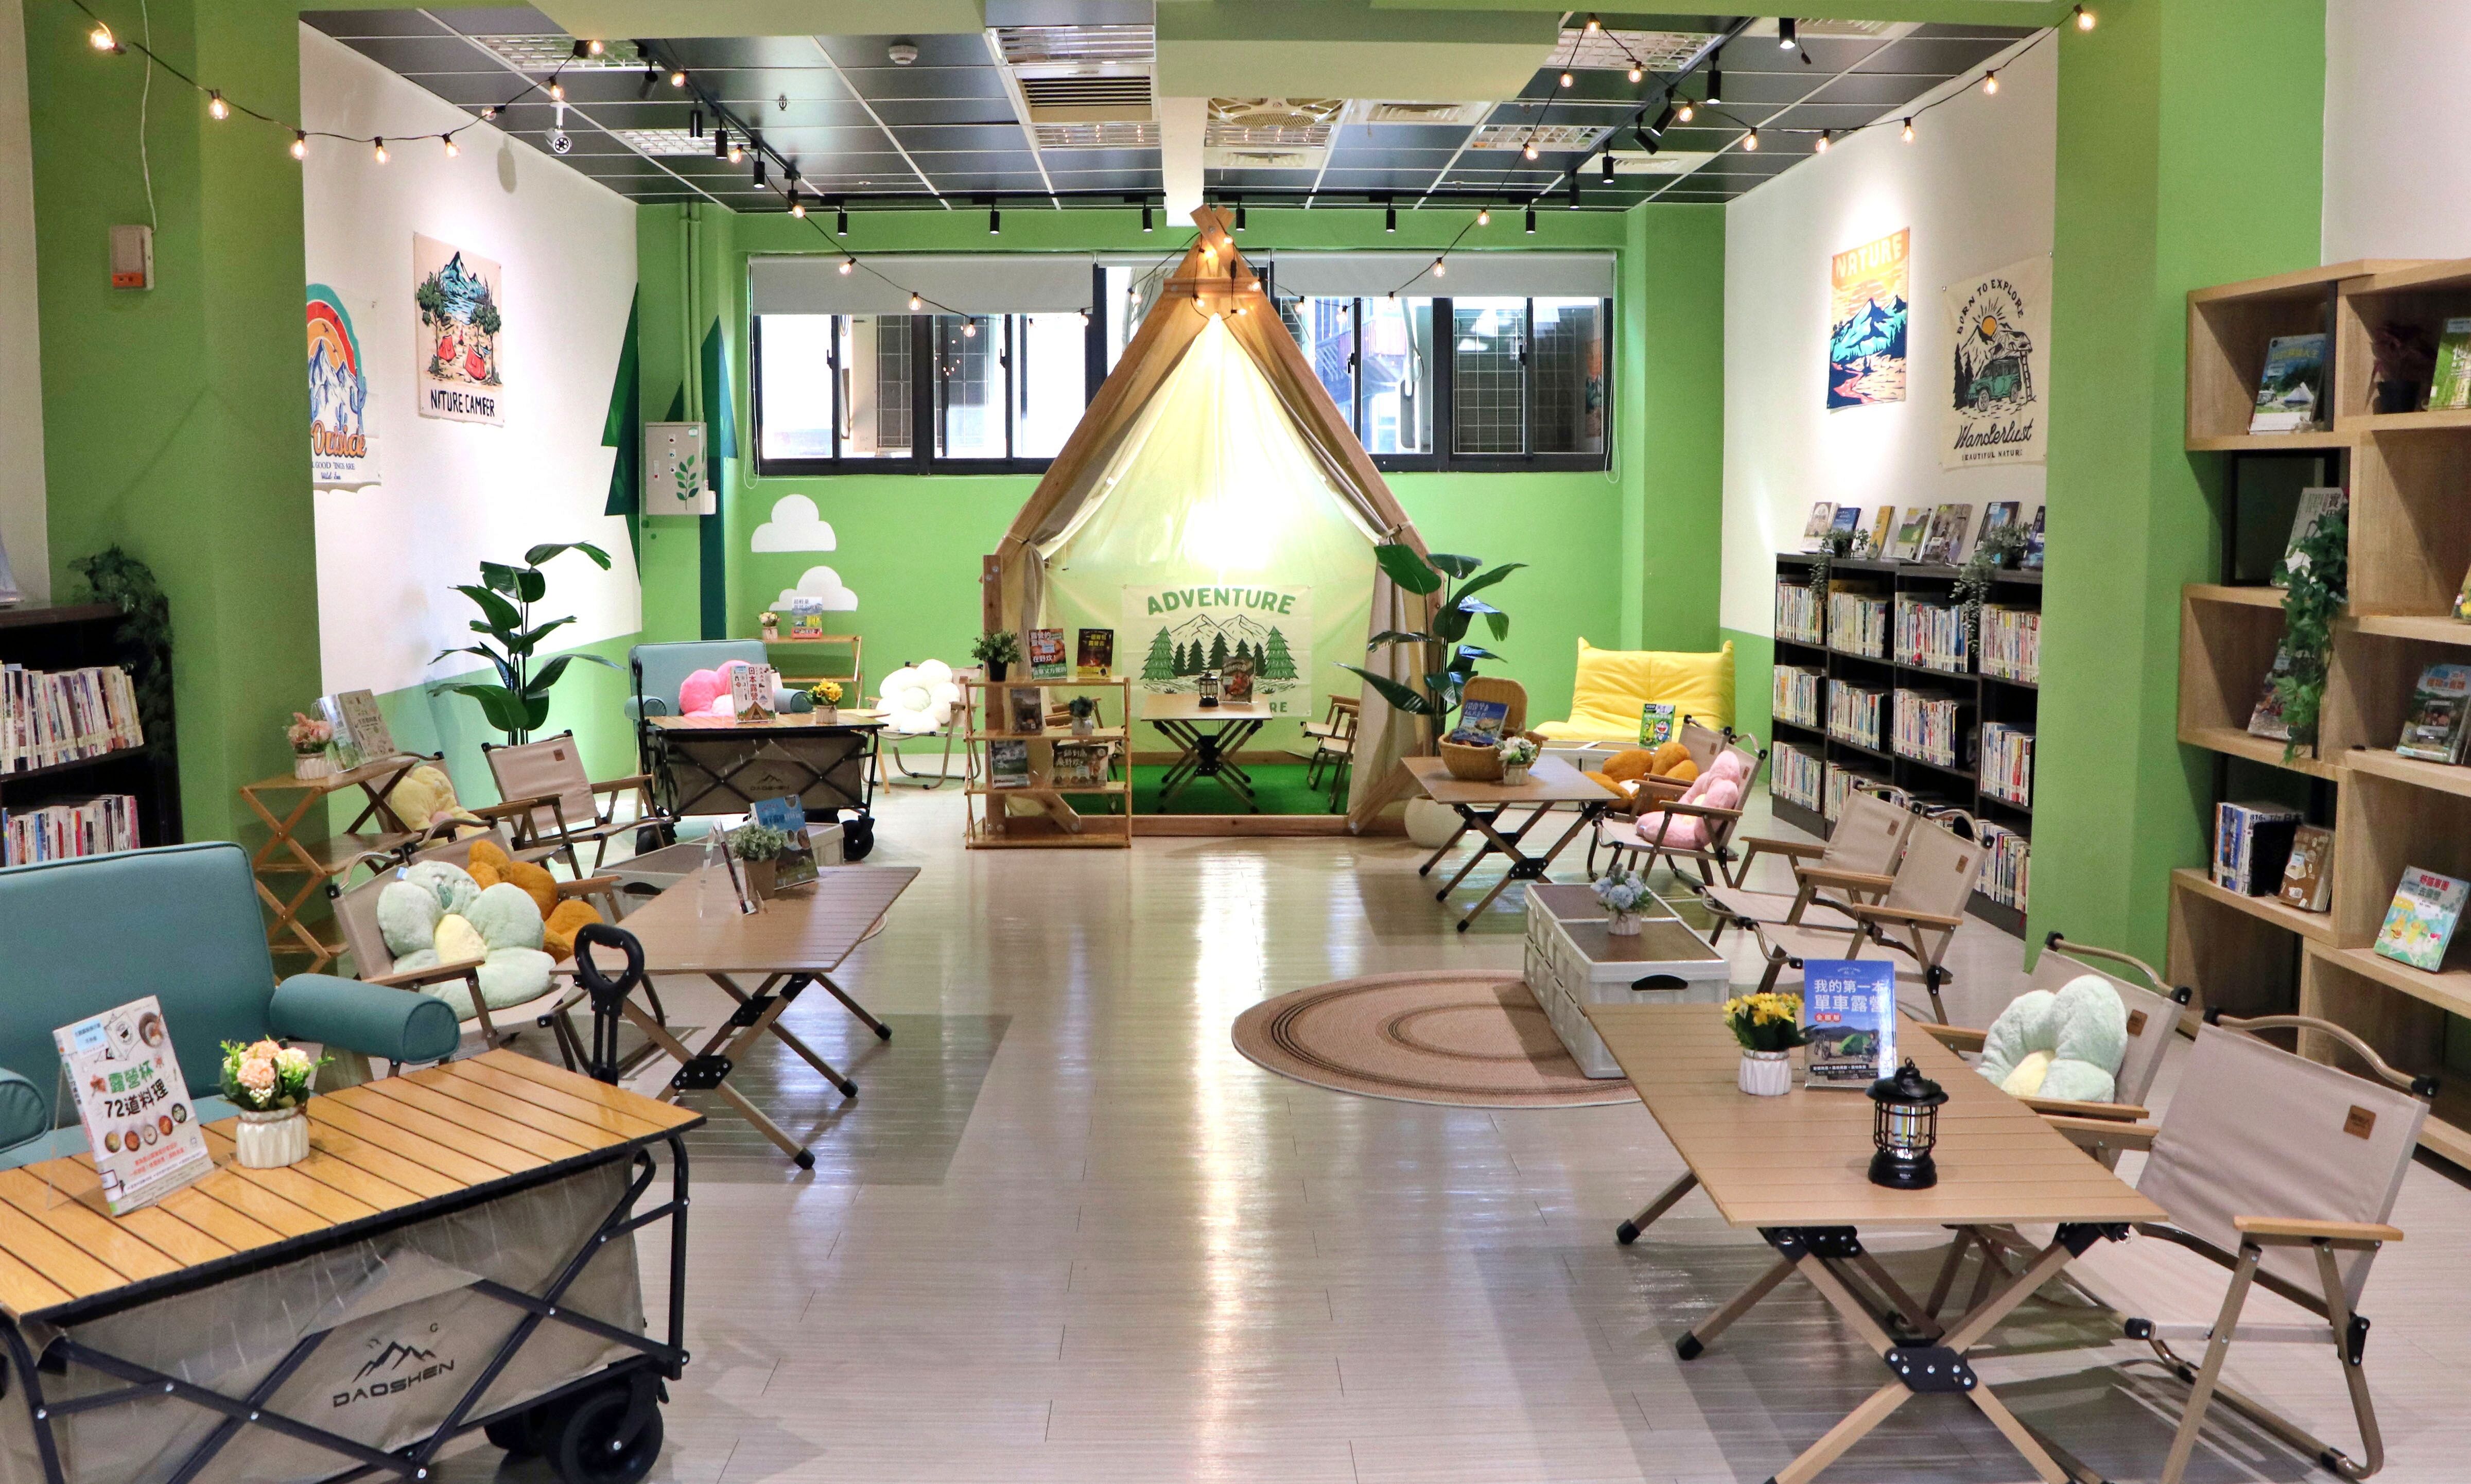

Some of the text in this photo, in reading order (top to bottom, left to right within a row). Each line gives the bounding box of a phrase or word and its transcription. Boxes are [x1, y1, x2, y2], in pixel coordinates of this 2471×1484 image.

[1836, 232, 1903, 278] NATURE
[1957, 279, 2024, 335] BORN TO EXPLORE
[1953, 417, 2034, 449] Wanderlust
[1961, 451, 1995, 461] EAUTIFUL
[1147, 587, 1296, 616] ADVENTURE
[1814, 979, 1886, 993] 我的第一本
[1814, 994, 1885, 1012] 單車露營
[108, 1060, 154, 1094] 露營杯
[104, 1078, 168, 1119] 72道料理
[333, 1359, 454, 1408] DAOSHEN
